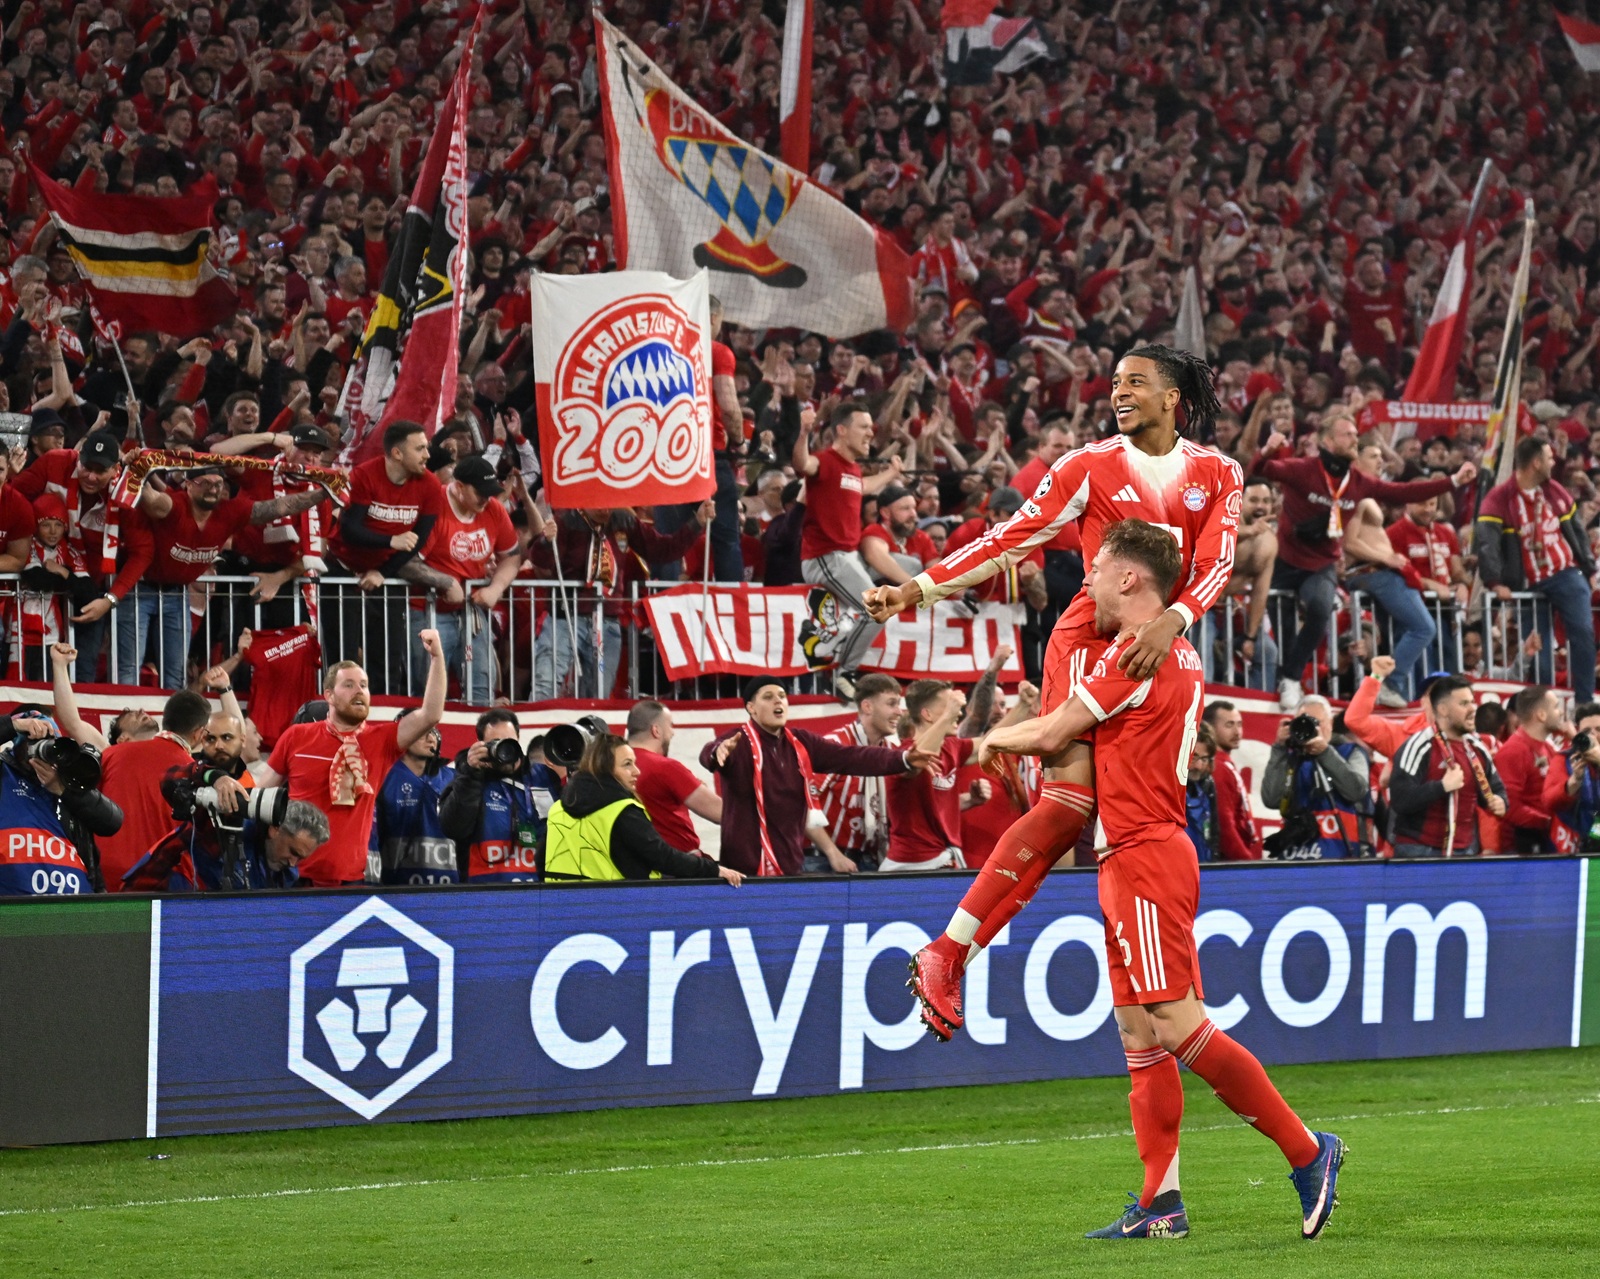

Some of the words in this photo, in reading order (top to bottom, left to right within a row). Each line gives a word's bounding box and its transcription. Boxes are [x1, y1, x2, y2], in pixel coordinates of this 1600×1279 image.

[571, 311, 685, 398] ALARMSTUFE
[553, 398, 712, 489] 2001
[31, 869, 80, 894] 099
[530, 901, 1488, 1096] cryptocom
